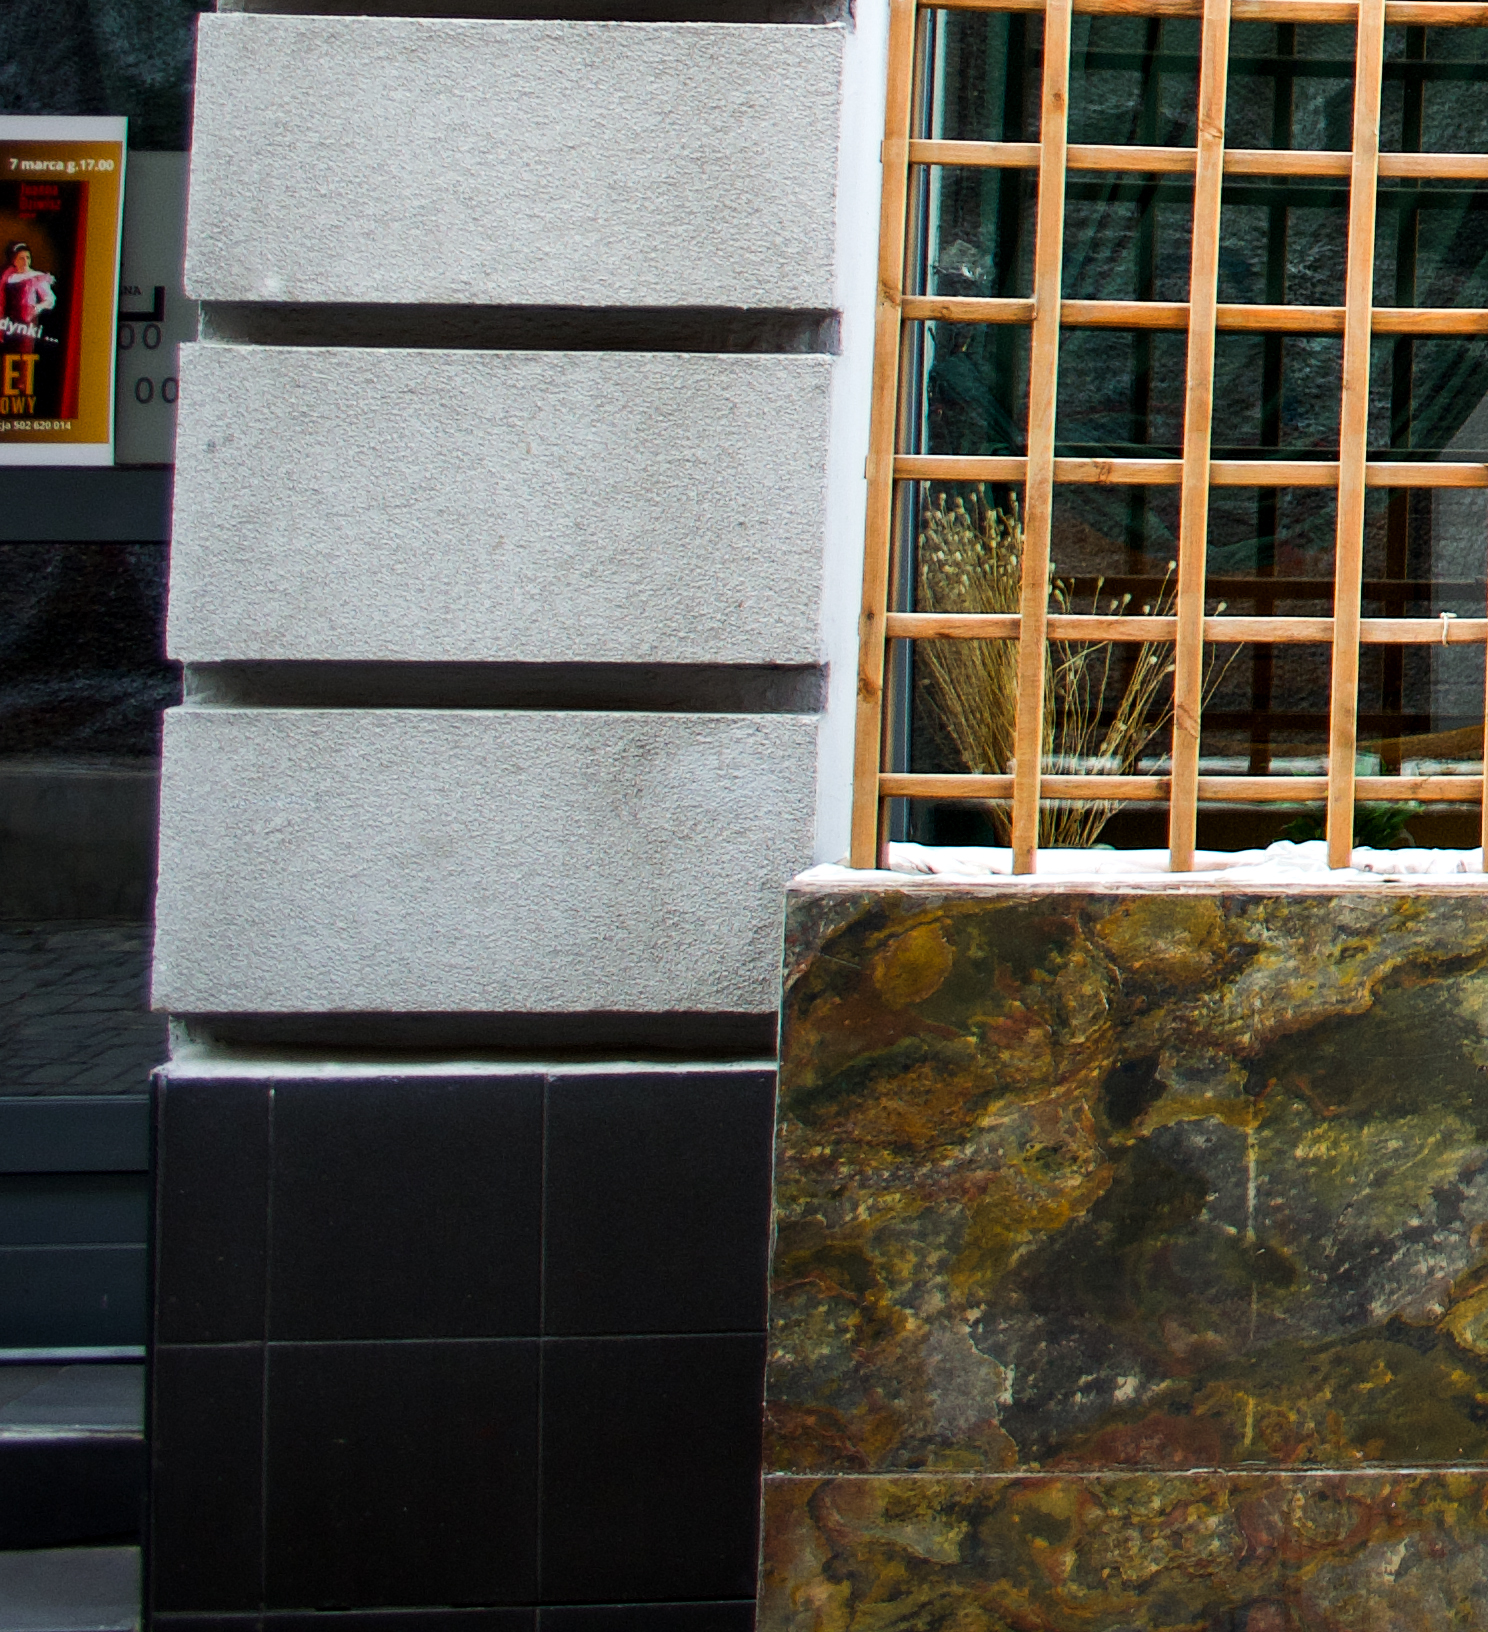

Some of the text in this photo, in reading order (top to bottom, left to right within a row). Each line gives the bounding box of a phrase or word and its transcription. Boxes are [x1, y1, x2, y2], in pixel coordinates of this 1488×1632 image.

[9, 158, 19, 170] 7
[21, 160, 65, 171] marca
[33, 420, 51, 430] 620
[53, 420, 71, 430] 014
